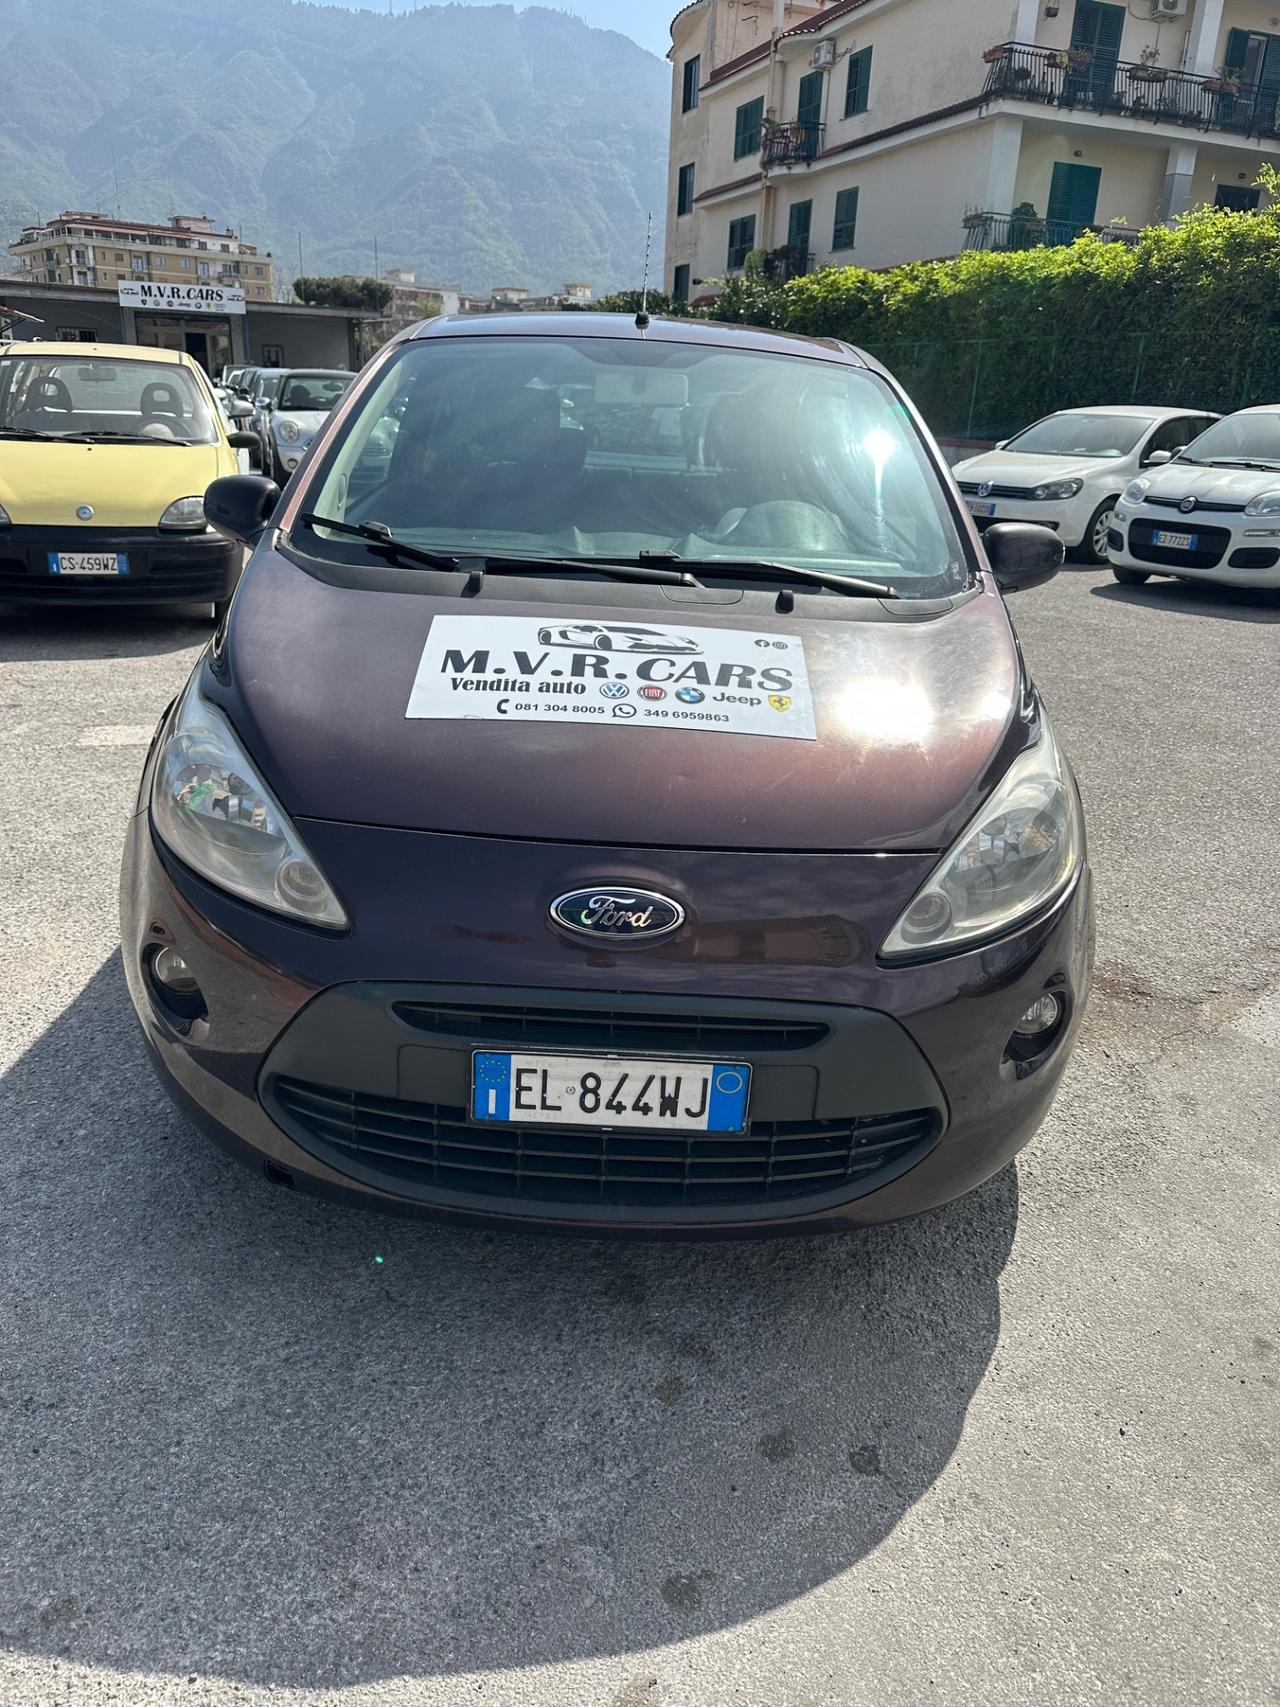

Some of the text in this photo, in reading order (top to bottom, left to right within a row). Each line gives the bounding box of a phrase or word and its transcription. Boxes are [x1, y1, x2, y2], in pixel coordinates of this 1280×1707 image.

[451, 677, 530, 693] Vendita
[537, 681, 586, 695] auto
[713, 692, 762, 707] Jeep
[515, 703, 730, 722] 081 304 8005 349 6959863
[580, 895, 654, 928] Ford
